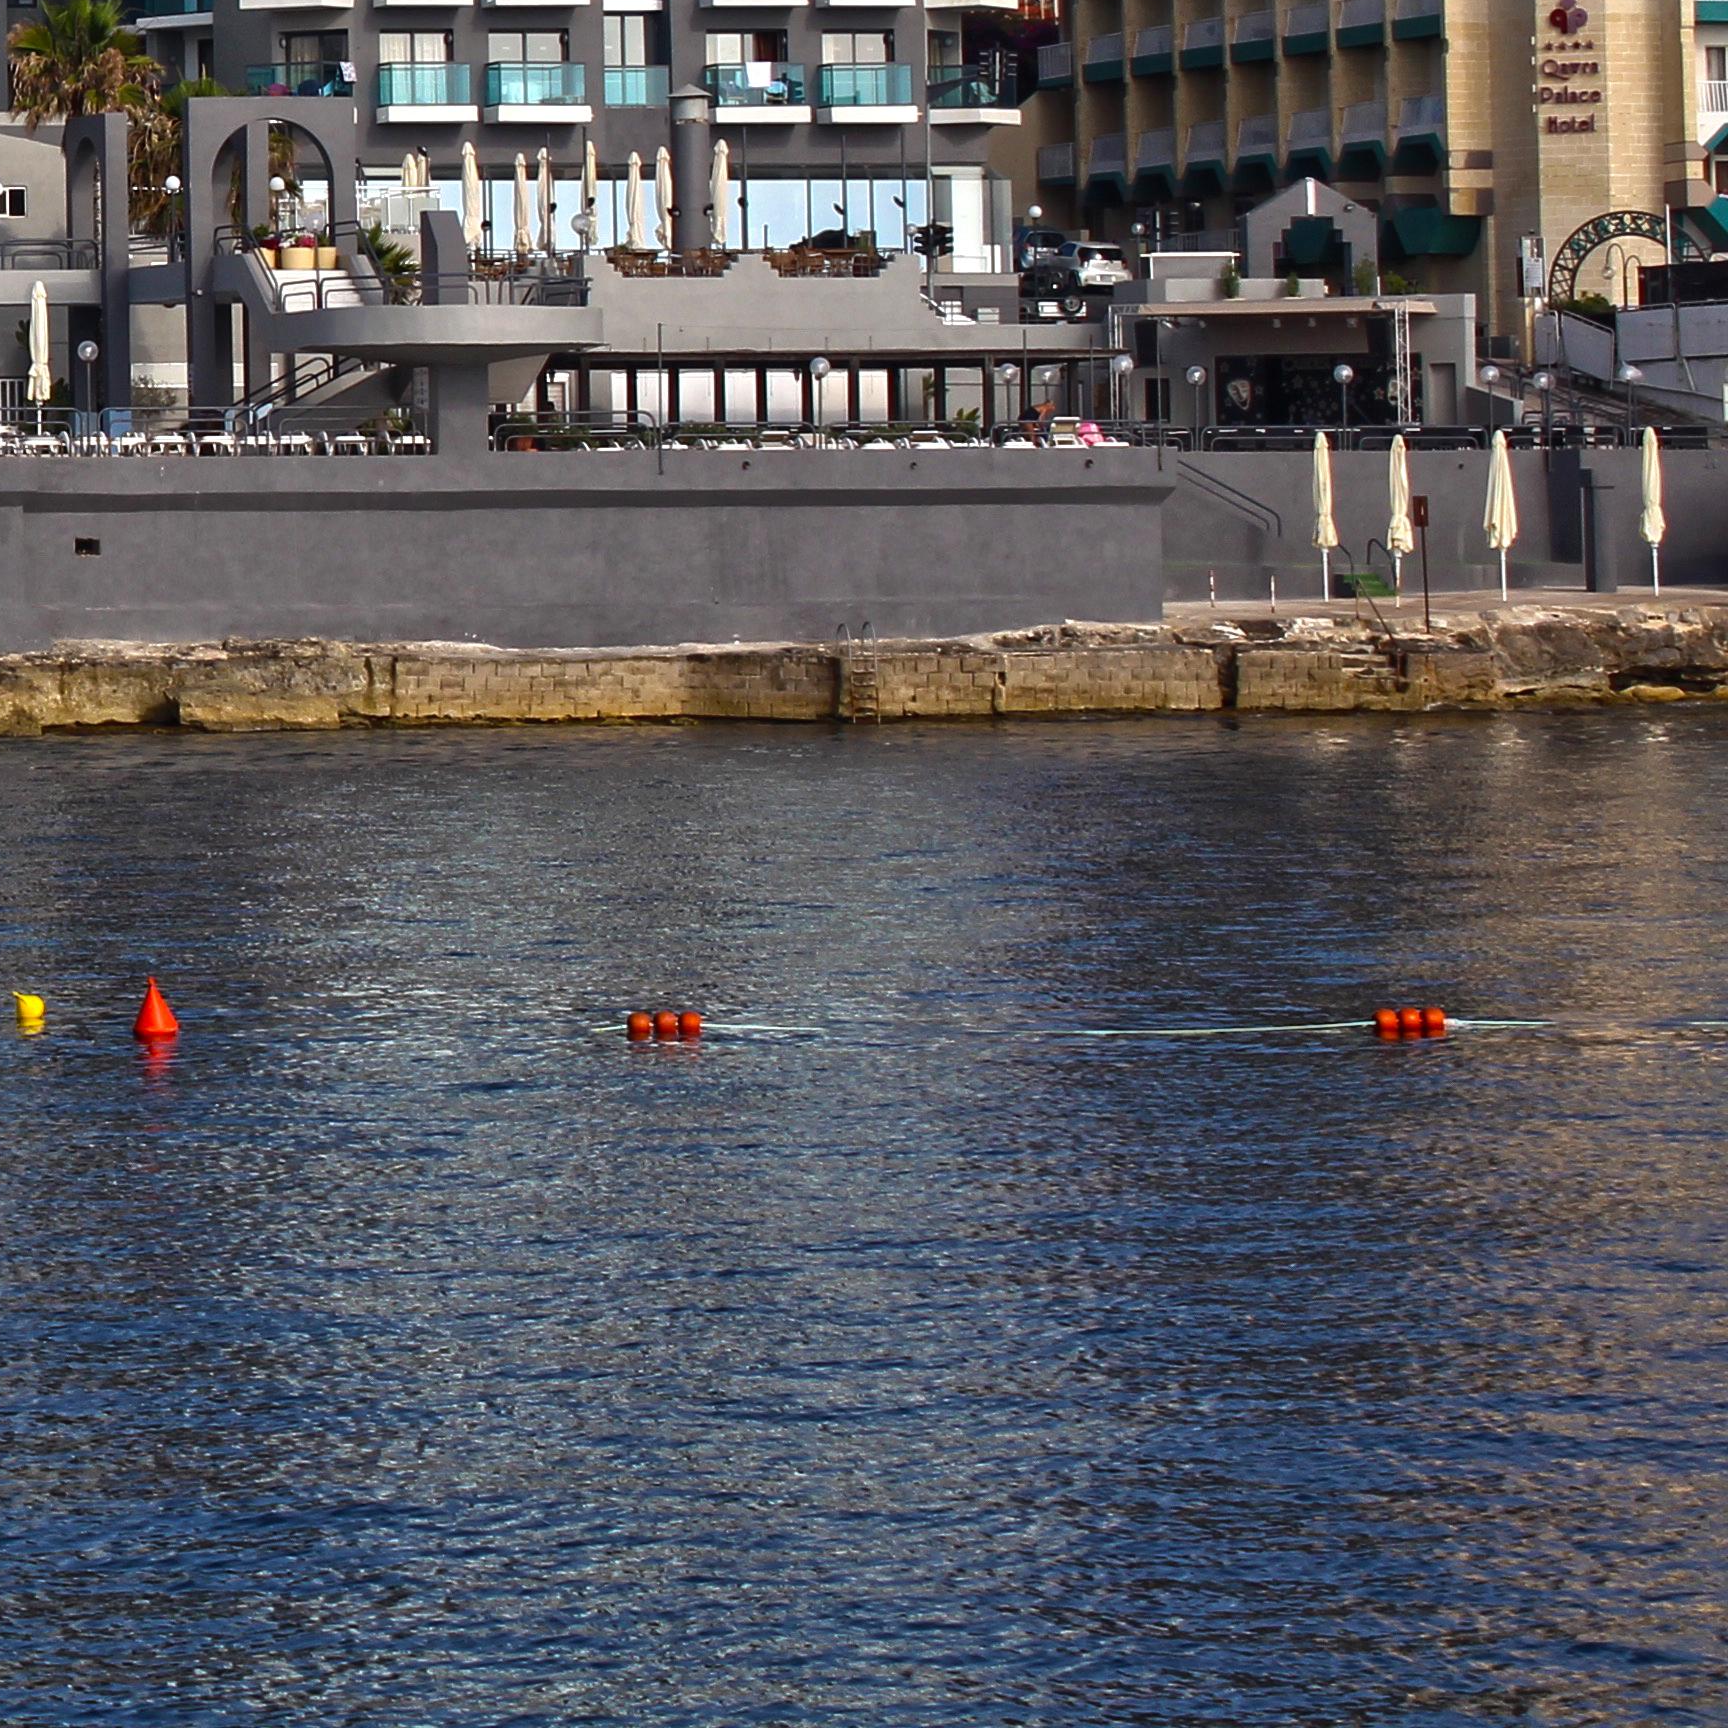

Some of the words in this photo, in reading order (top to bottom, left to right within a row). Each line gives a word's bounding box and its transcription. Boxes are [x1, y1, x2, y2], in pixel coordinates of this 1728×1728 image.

[1542, 59, 1600, 81] Qawra
[1539, 86, 1602, 104] Palace
[1547, 112, 1597, 134] Hotel
